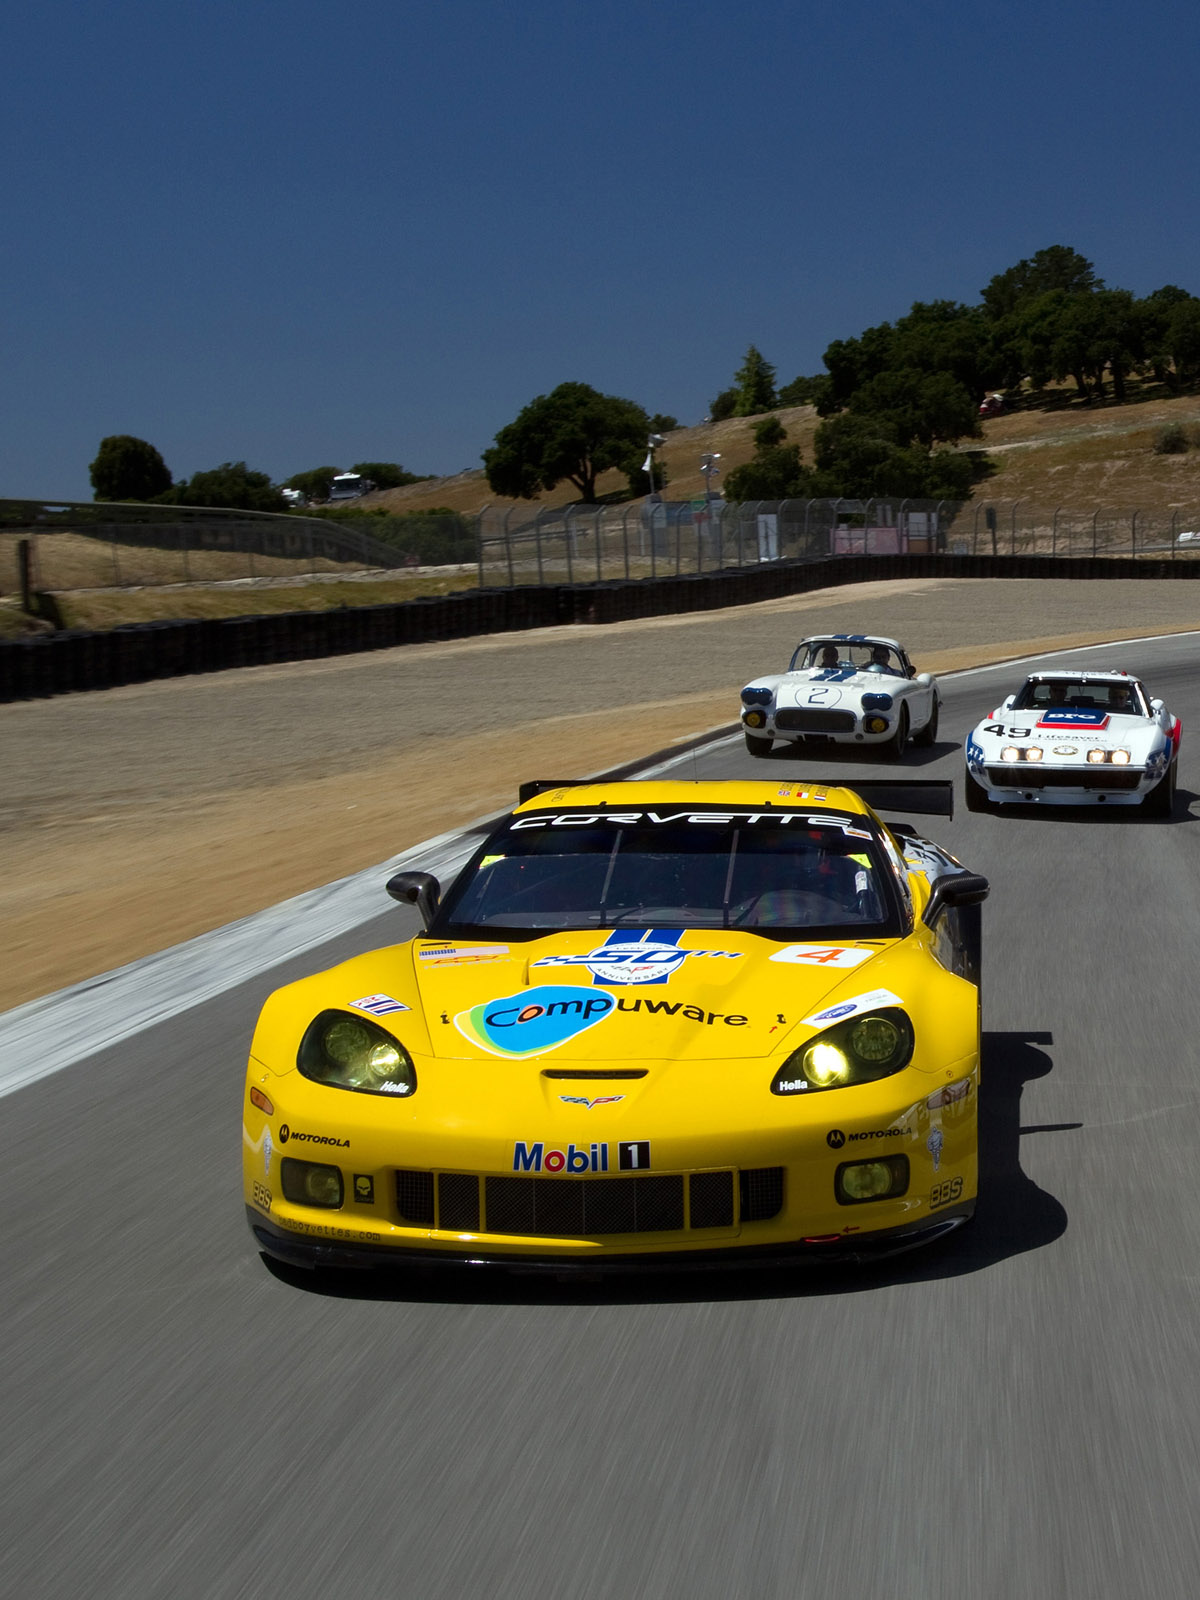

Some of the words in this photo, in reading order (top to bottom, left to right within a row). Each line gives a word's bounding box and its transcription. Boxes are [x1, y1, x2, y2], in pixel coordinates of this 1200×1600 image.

[808, 687, 829, 704] 2
[983, 724, 1032, 738] 49
[510, 812, 852, 830] CORVETTE
[796, 949, 846, 964] 4
[597, 967, 669, 981] ANNIVERSARY
[485, 998, 749, 1027] Compuware
[380, 1081, 410, 1093] Hella
[780, 1080, 808, 1091] Hella
[291, 1132, 350, 1148] MOTOROLA
[849, 1127, 912, 1142] MOTOROLA
[513, 1141, 609, 1174] Mobil
[253, 1181, 272, 1214] BBS
[930, 1176, 963, 1210] BBS
